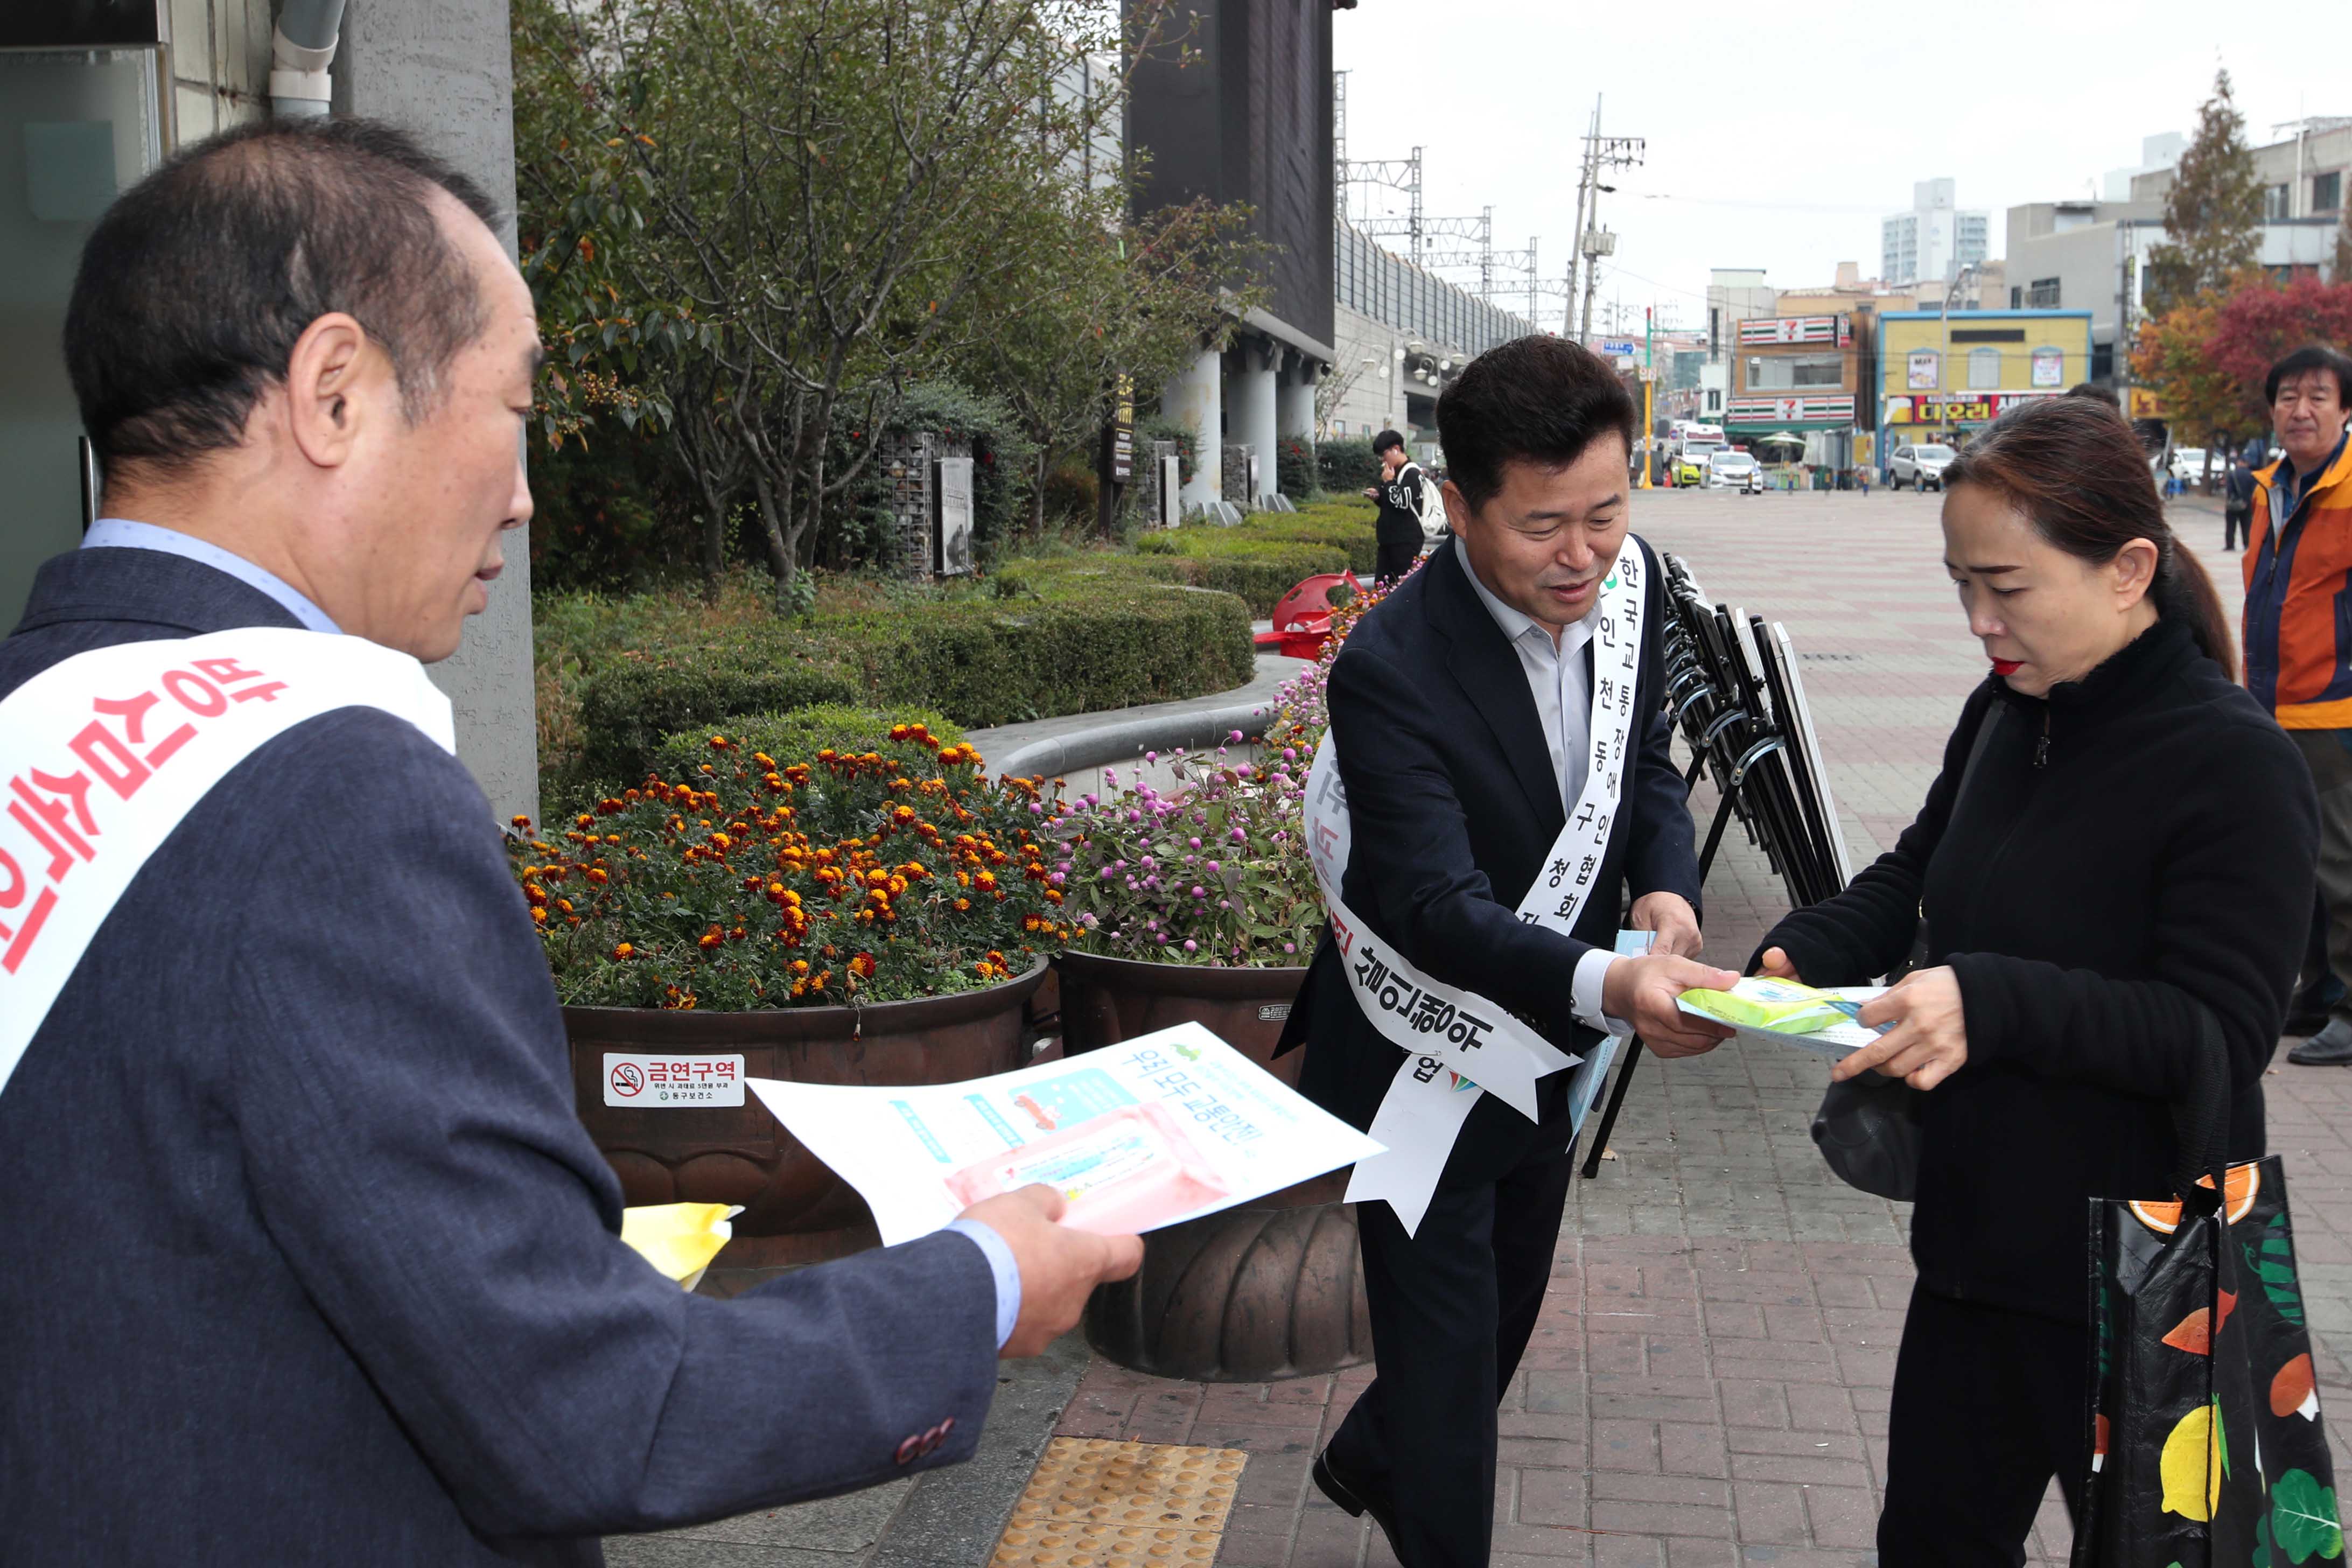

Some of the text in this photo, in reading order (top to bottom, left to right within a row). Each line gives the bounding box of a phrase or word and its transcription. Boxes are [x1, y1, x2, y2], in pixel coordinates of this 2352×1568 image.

[1354, 947, 1494, 1052] 살인행위
[648, 1061, 735, 1081] 금연구역
[1122, 1050, 1174, 1079] 우리
[1154, 1071, 1201, 1099] 모두
[673, 1091, 713, 1100] 동구보건소
